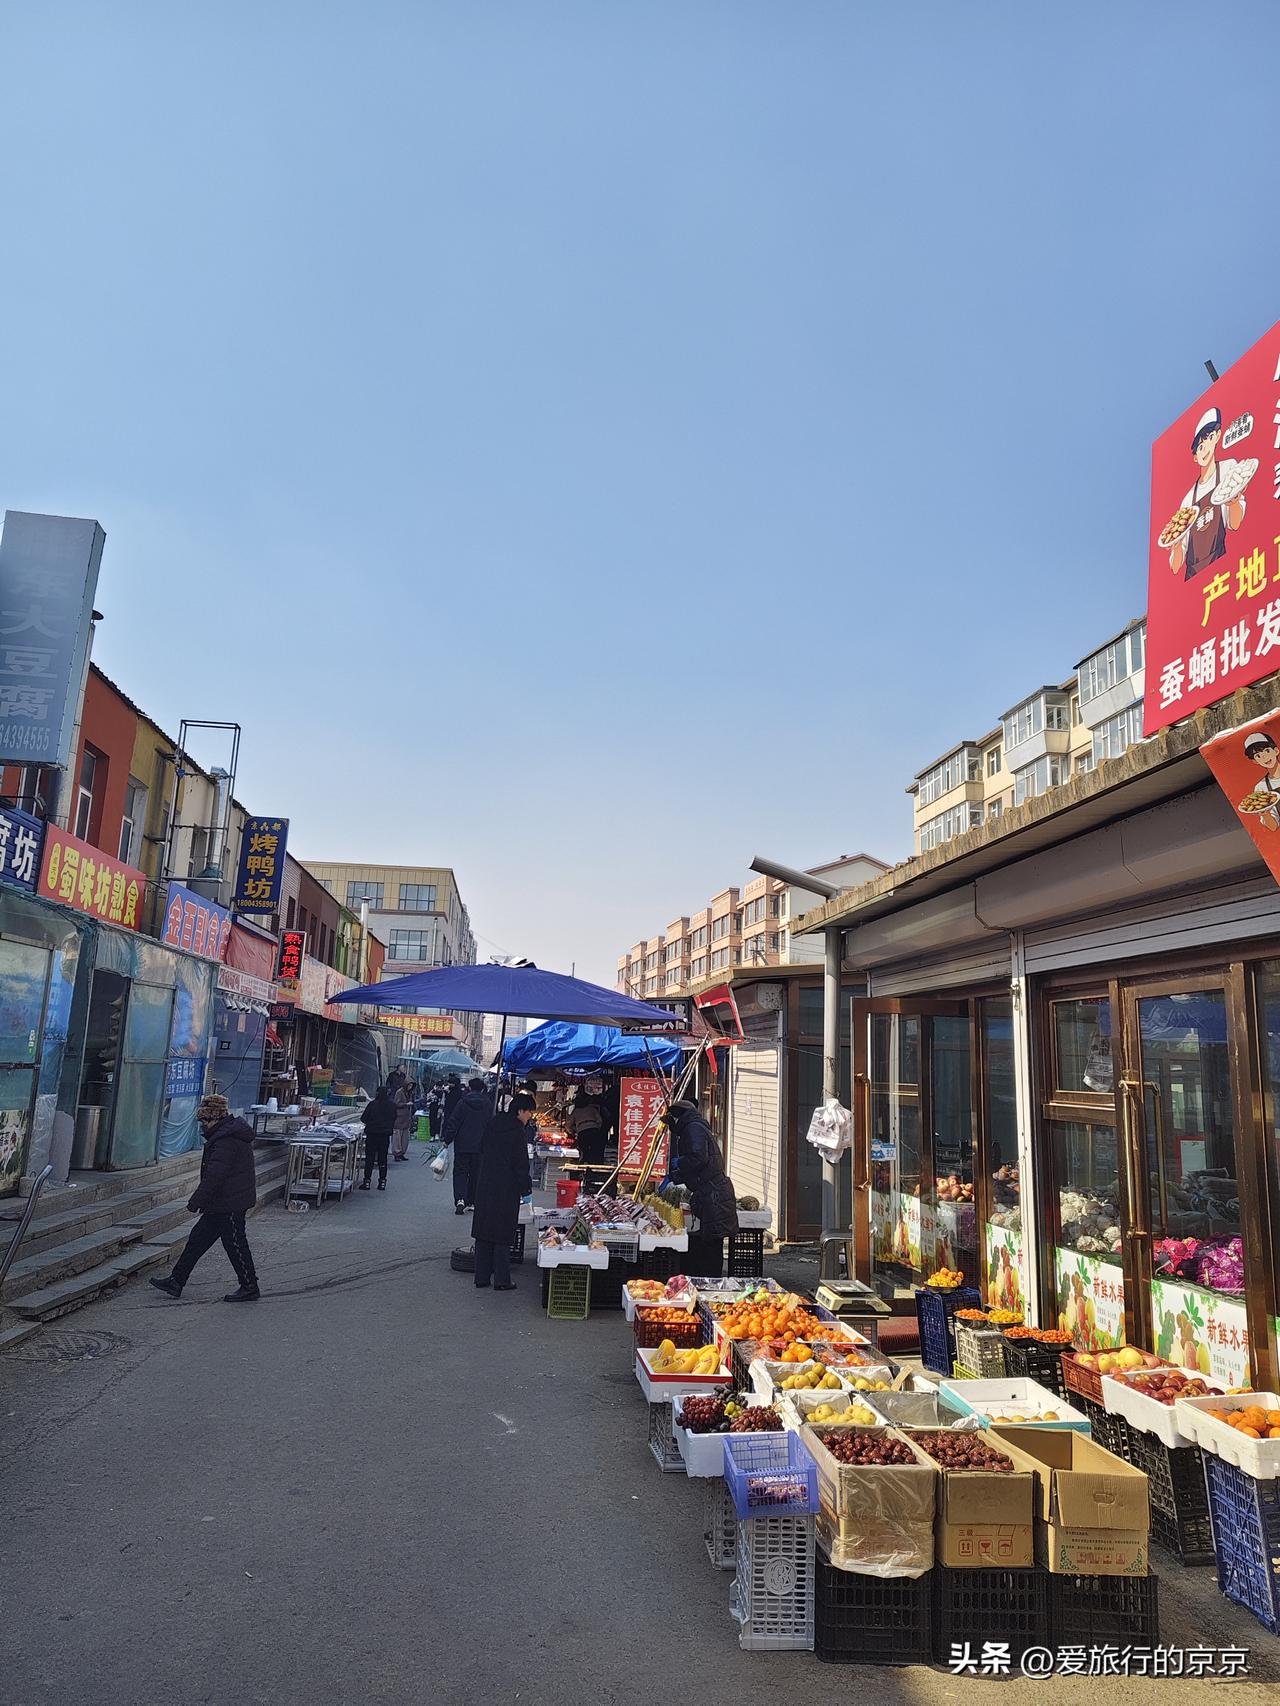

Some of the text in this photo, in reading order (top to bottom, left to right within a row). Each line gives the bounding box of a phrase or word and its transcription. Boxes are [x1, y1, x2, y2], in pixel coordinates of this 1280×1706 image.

[1159, 597, 1280, 709] 蚕蛹批发
[59, 846, 139, 927] 蜀味坊熟食
[244, 833, 278, 899] 烤鸭坊
[276, 932, 302, 979] 熟食鸭货
[623, 1094, 645, 1165] 袁佳佳大酱
[1093, 1277, 1124, 1305] 新鲜水果
[1206, 1317, 1249, 1354] 新鲜水果
